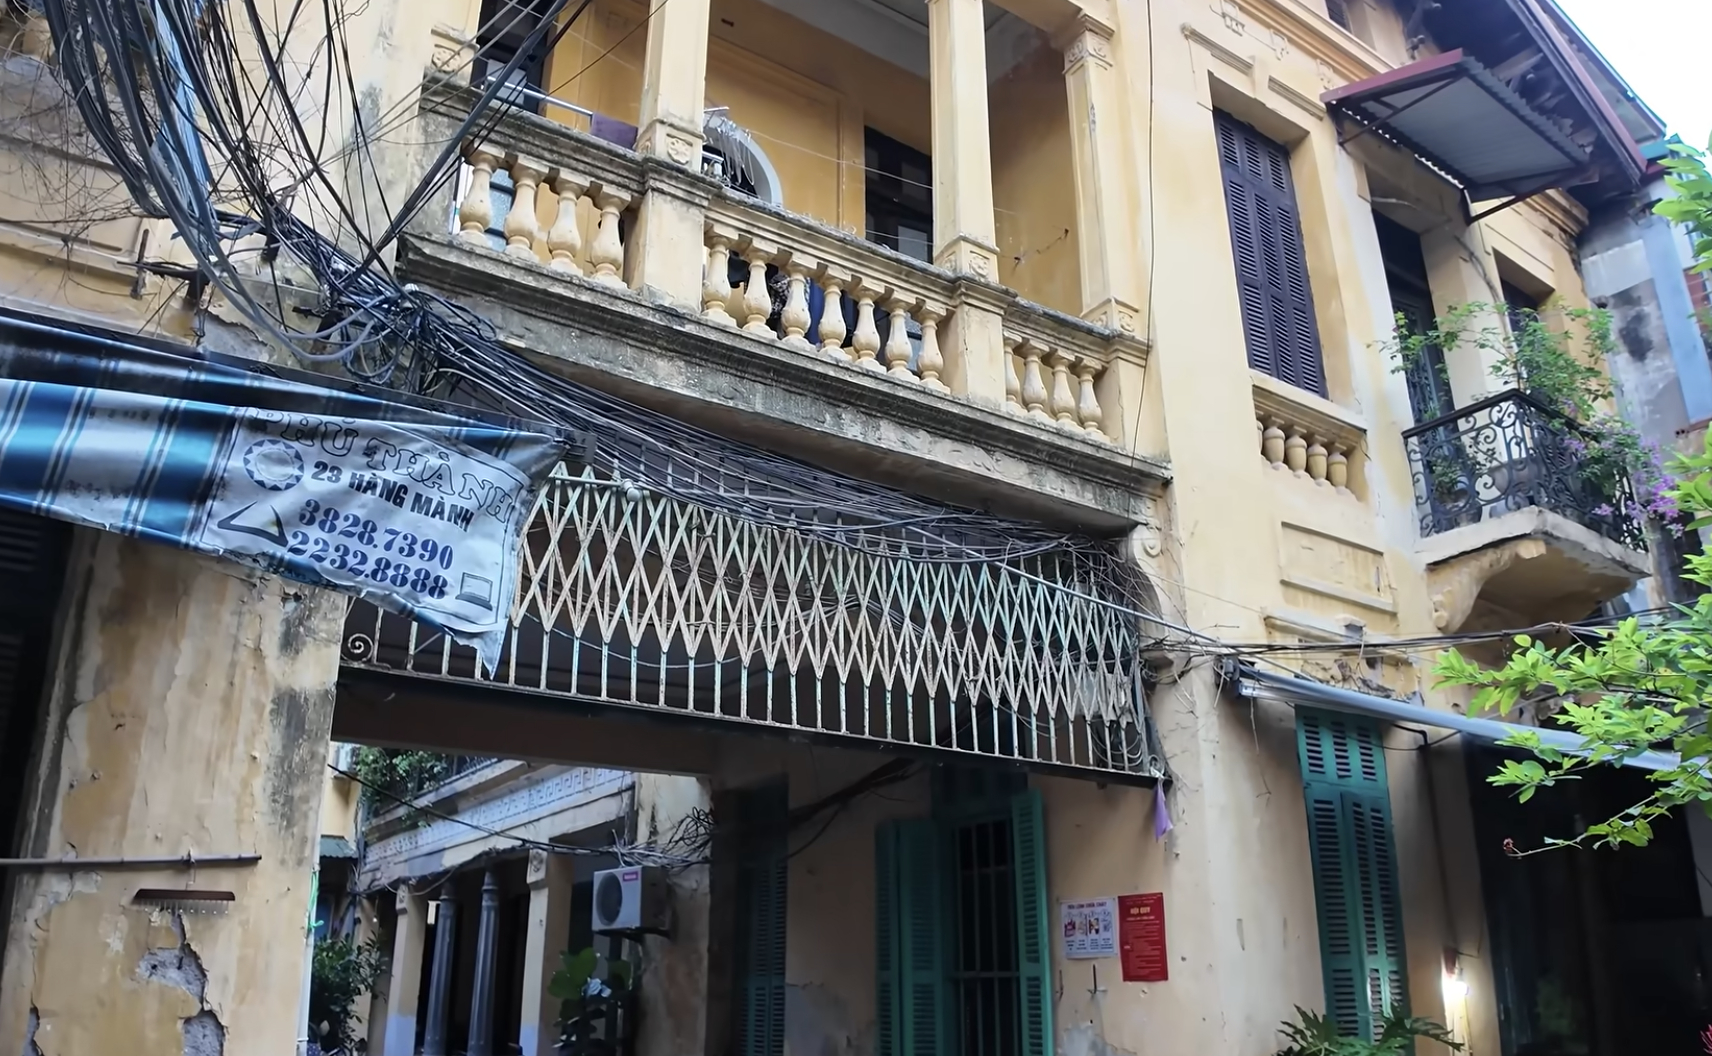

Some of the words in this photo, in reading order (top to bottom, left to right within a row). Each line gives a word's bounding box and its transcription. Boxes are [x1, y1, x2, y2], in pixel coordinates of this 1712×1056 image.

[311, 460, 343, 483] 23
[348, 471, 409, 508] HÀNG
[410, 492, 475, 533] MÀNH
[286, 530, 449, 600] 2232.8888
[299, 498, 454, 570] 3828.7390
